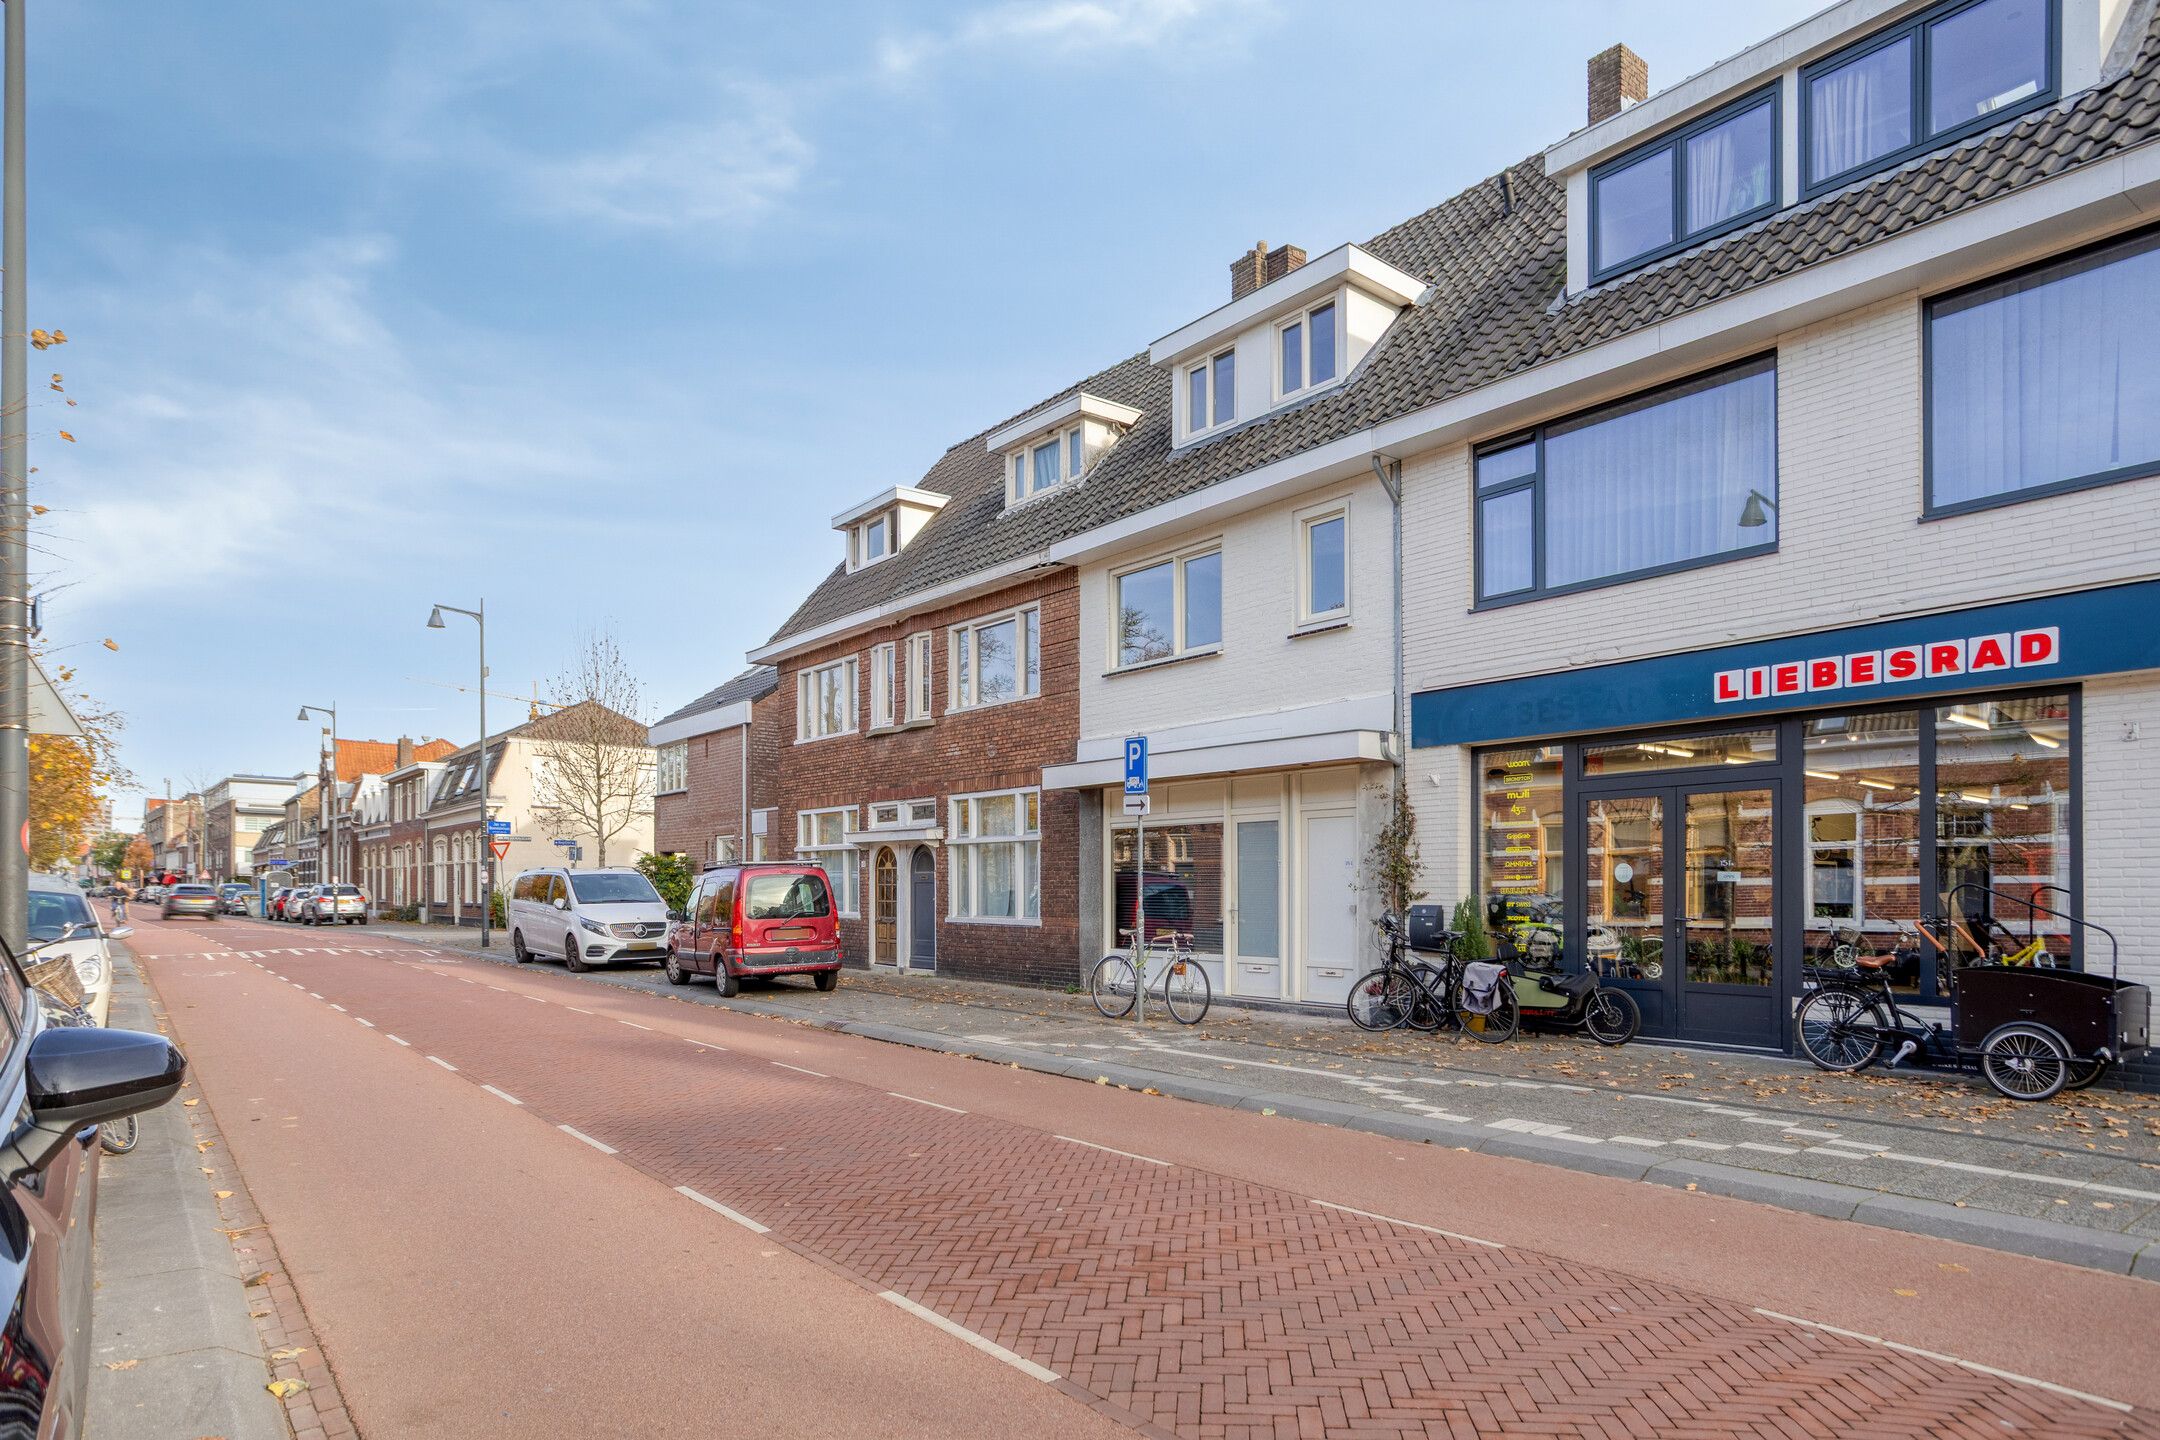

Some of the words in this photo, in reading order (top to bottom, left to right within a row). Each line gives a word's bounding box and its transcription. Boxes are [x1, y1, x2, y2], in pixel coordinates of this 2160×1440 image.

[1718, 631, 2052, 700] LIEBESRAD
[1129, 743, 1141, 770] P
[1505, 775, 1532, 783] BROMPTON
